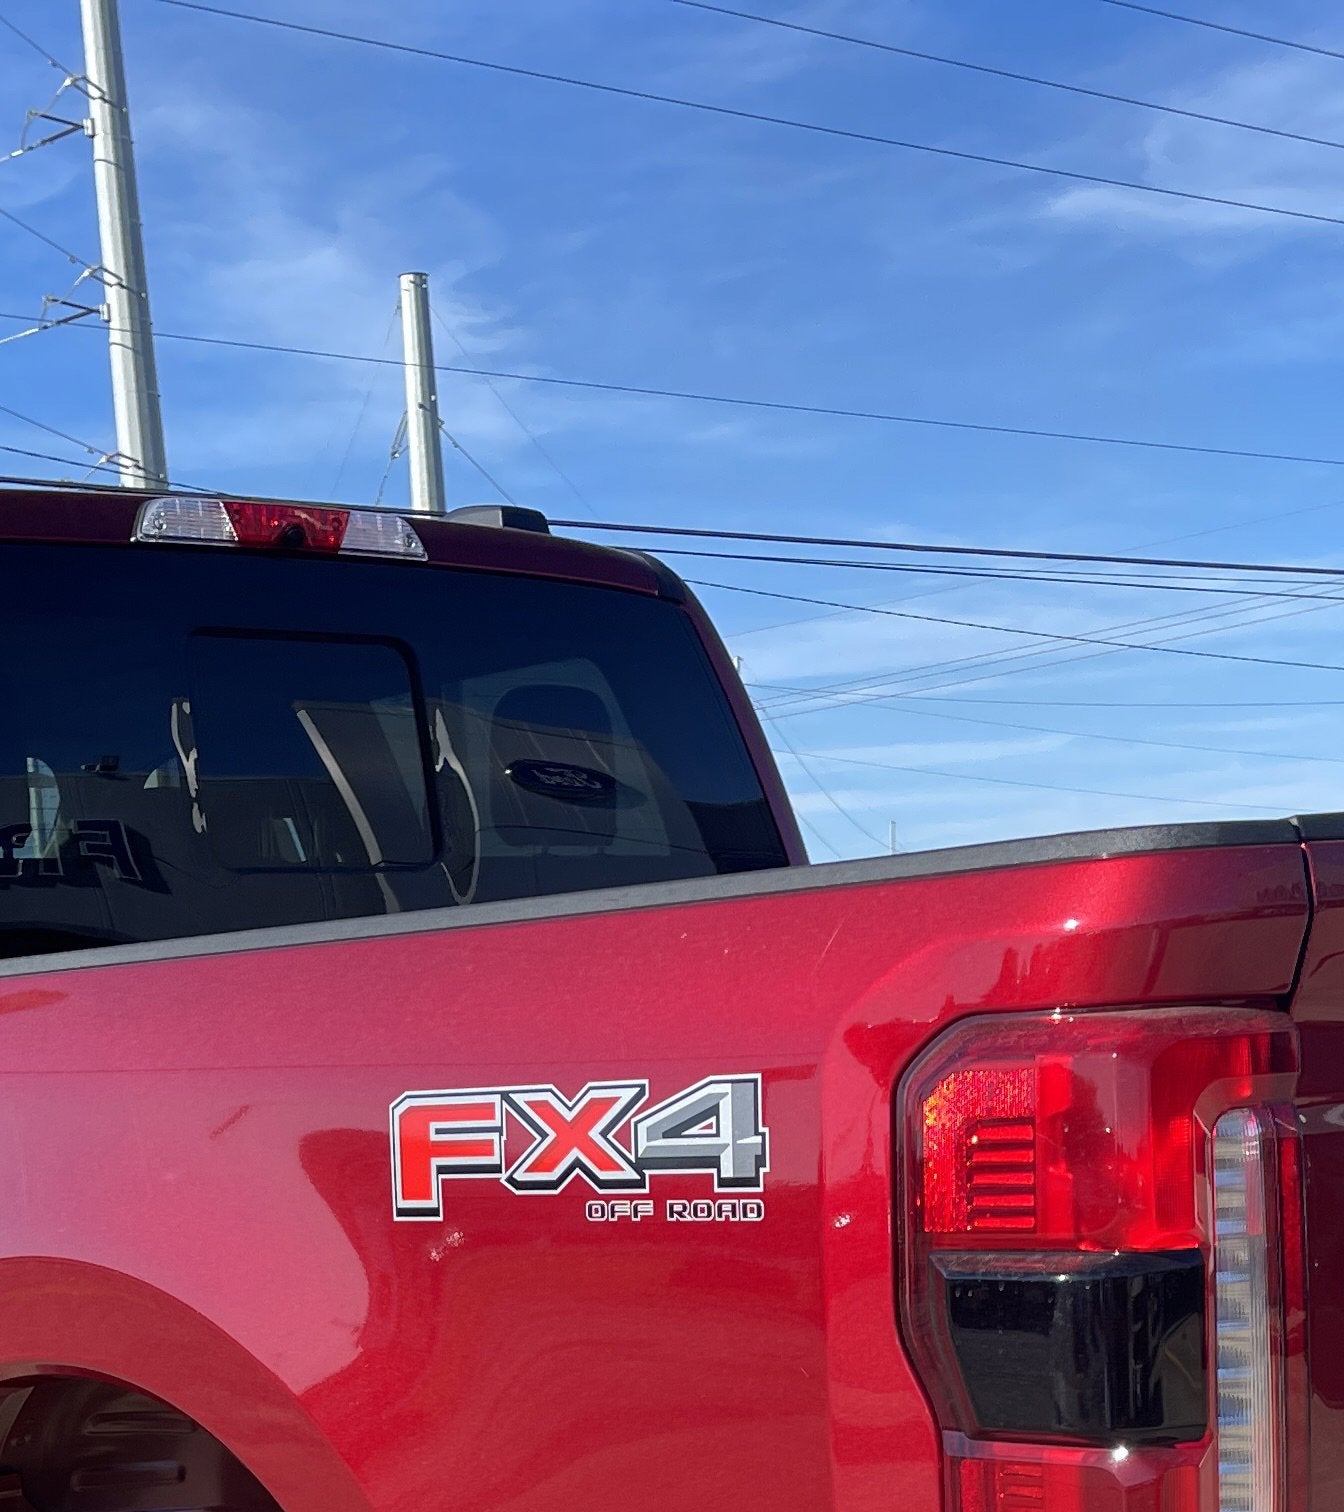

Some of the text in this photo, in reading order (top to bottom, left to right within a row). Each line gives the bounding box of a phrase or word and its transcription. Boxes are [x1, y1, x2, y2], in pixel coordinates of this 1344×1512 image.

[389, 1073, 770, 1222] FX4
[586, 1199, 765, 1222] OFF ROAD
